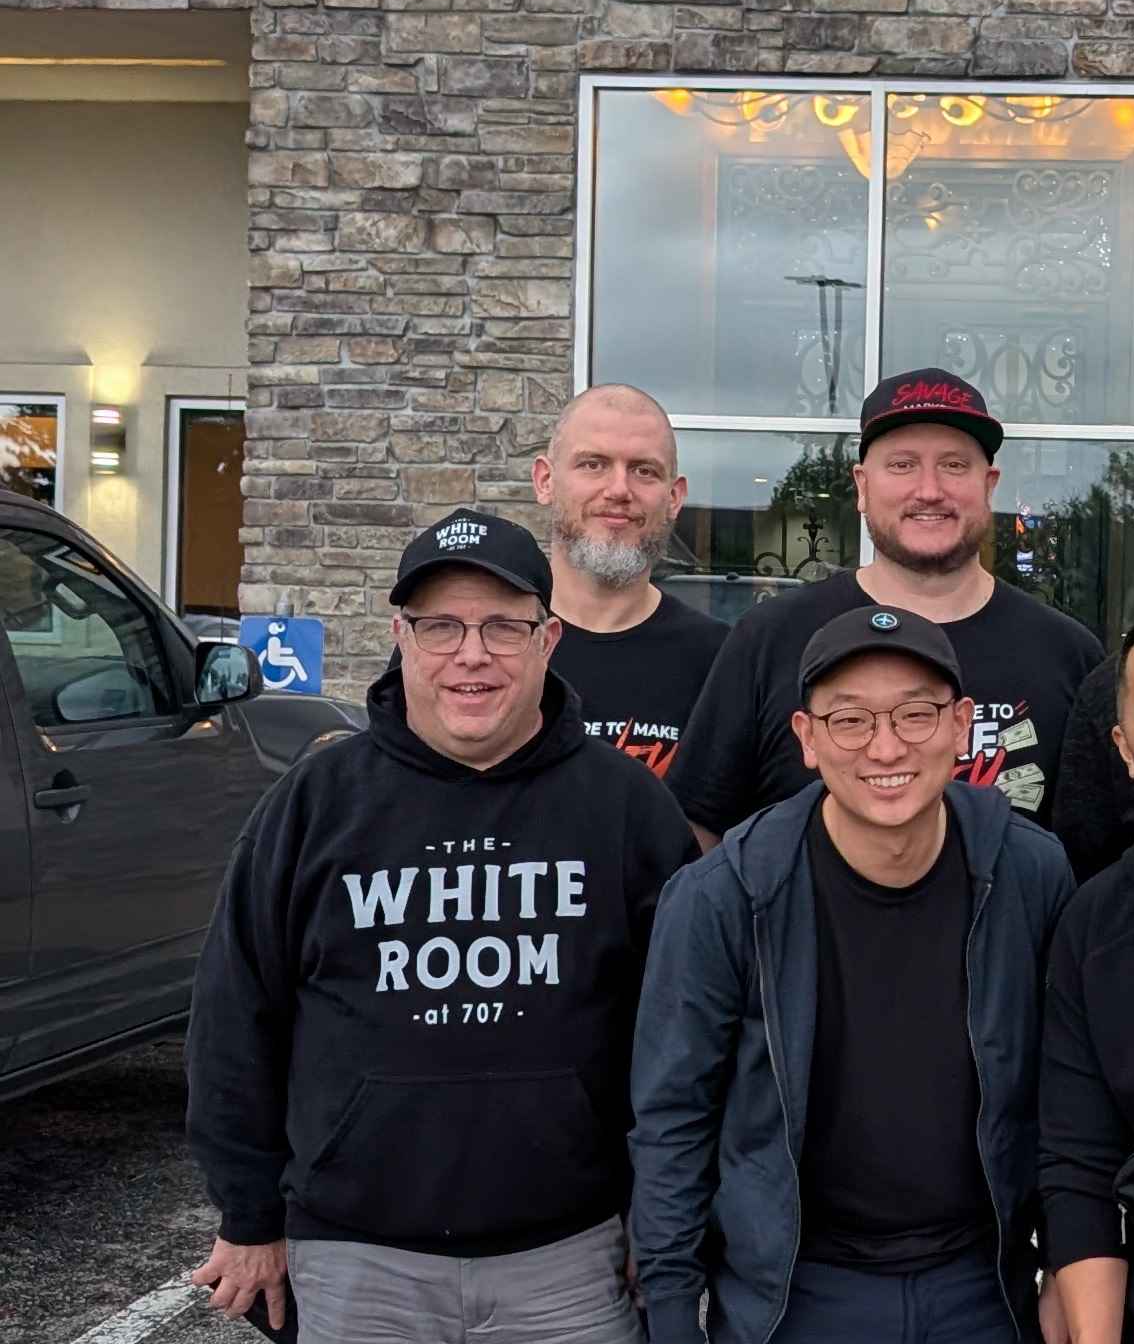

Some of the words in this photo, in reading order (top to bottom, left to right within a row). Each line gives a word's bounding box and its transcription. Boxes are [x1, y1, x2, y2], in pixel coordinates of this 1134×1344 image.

[892, 378, 972, 411] SAVAGE
[436, 522, 487, 541] WHITE
[439, 534, 480, 549] ROOM
[988, 703, 1014, 720] TO
[633, 721, 679, 741] MAKE
[342, 860, 587, 929] WHITE
[376, 933, 560, 992] ROOM
